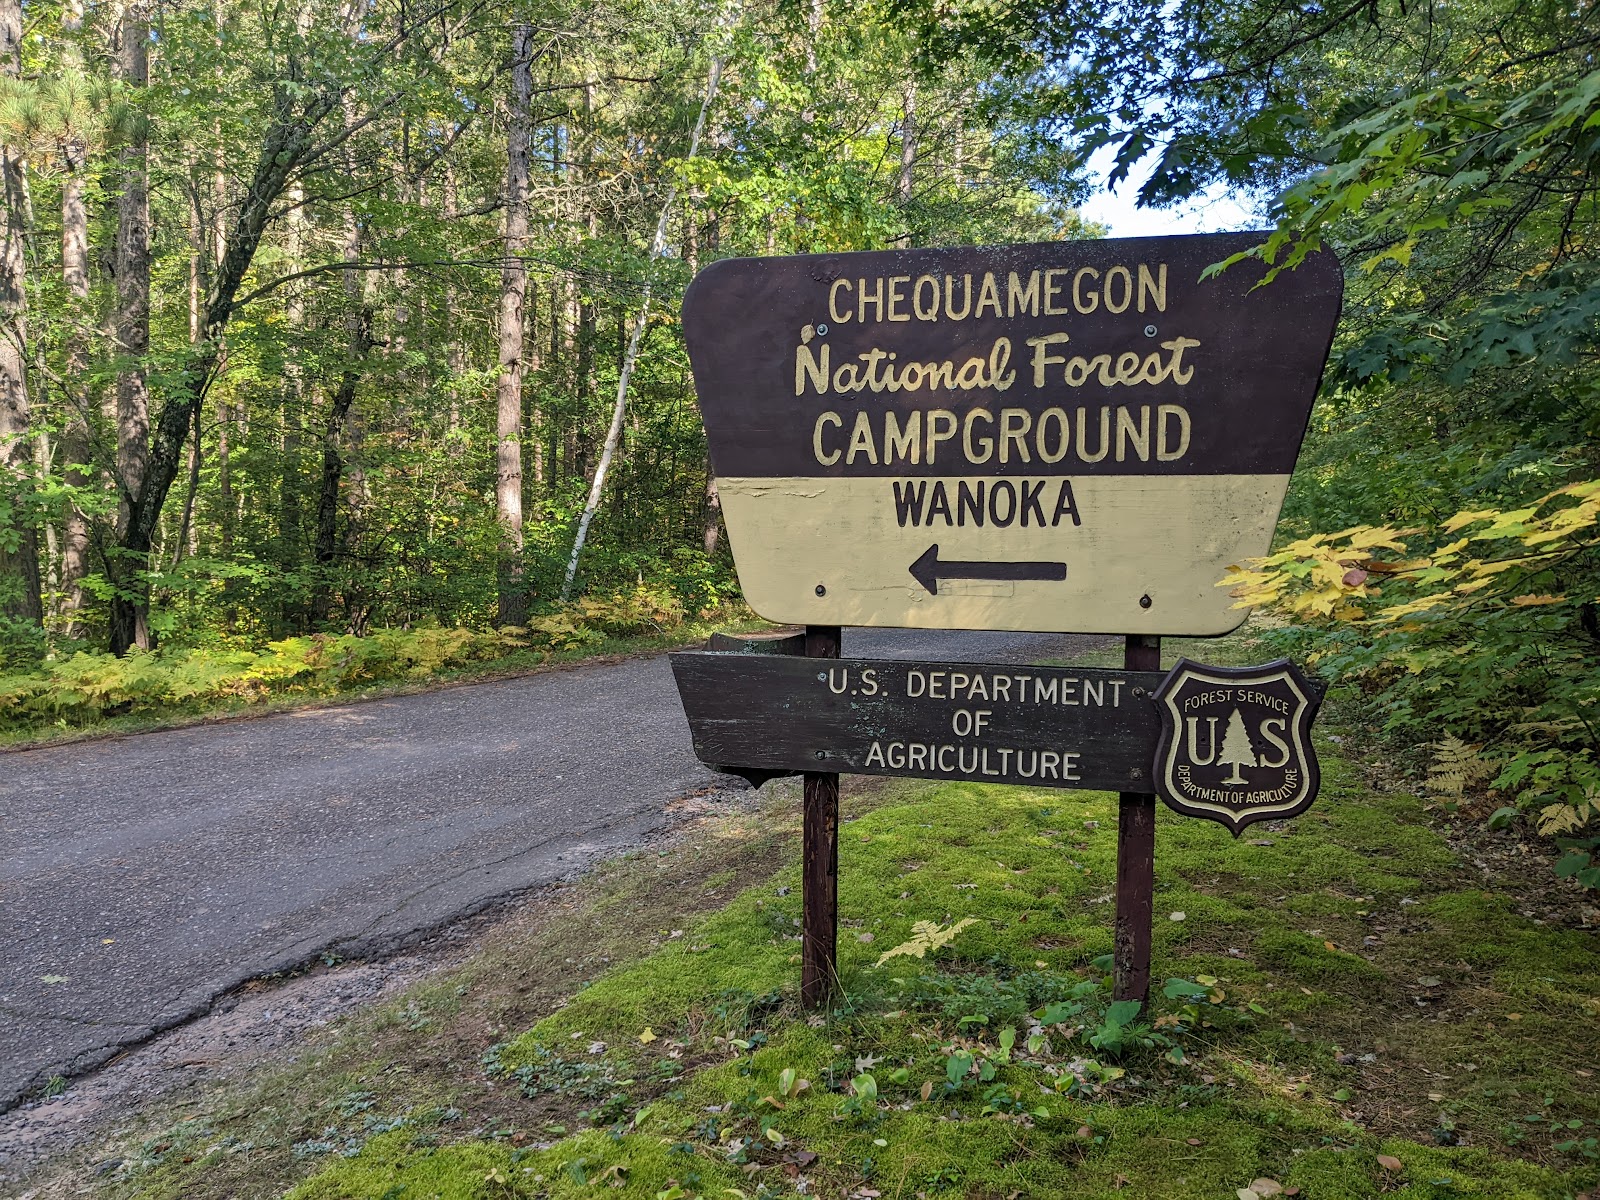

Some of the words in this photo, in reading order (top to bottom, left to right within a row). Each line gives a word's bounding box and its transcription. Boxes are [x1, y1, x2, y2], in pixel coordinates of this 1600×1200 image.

[828, 263, 1168, 324] CHEQUAMEGON
[795, 336, 1018, 396] National
[1026, 332, 1201, 388] Forest
[812, 403, 1191, 466] CAMPGROUND
[892, 479, 1082, 528] WANOKA
[828, 668, 889, 696] U.S.
[907, 670, 1127, 709] DEPARTMENT
[1184, 690, 1233, 713] FOREST
[1237, 689, 1289, 716] SERVICE
[953, 709, 993, 738] OF
[865, 741, 1082, 782] AGRICULTURE
[1177, 765, 1230, 803] DEPARTMENT
[1231, 791, 1244, 804] OF
[1246, 768, 1298, 804] AGRICULTURE
